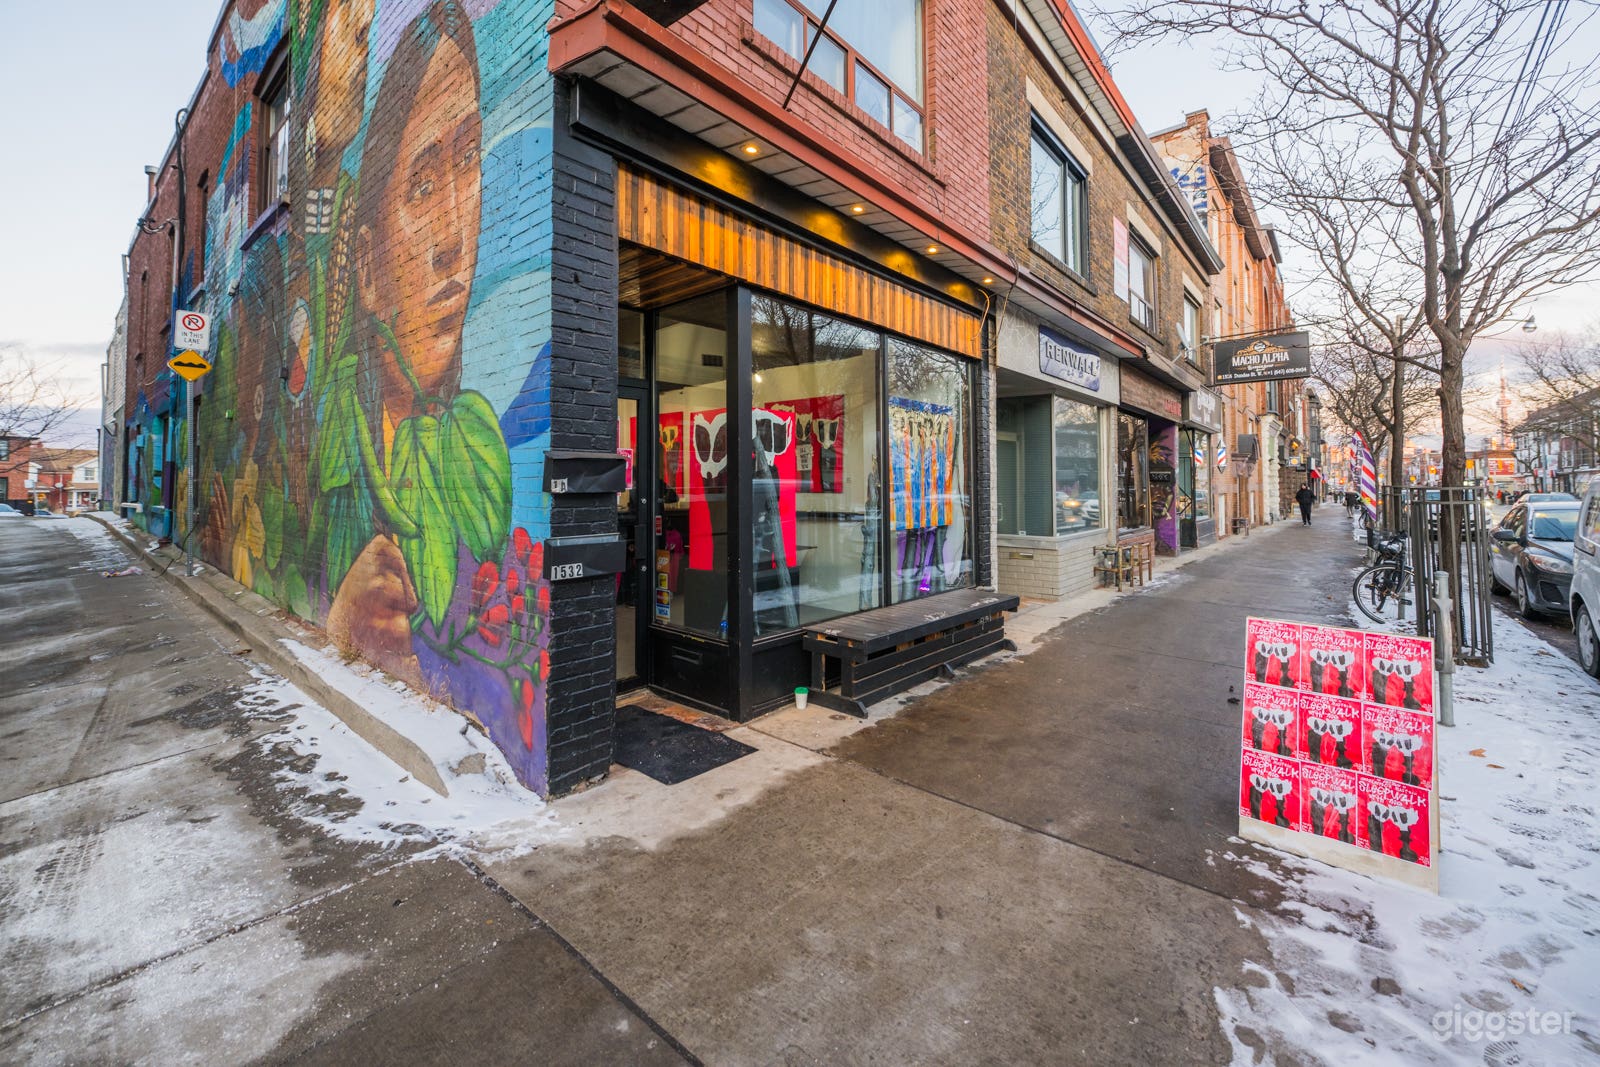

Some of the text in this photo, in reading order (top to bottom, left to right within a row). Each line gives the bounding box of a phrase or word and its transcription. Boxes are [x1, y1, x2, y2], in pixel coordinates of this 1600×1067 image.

[1232, 352, 1289, 367] MACHO ALPHA
[553, 564, 582, 579] 1532
